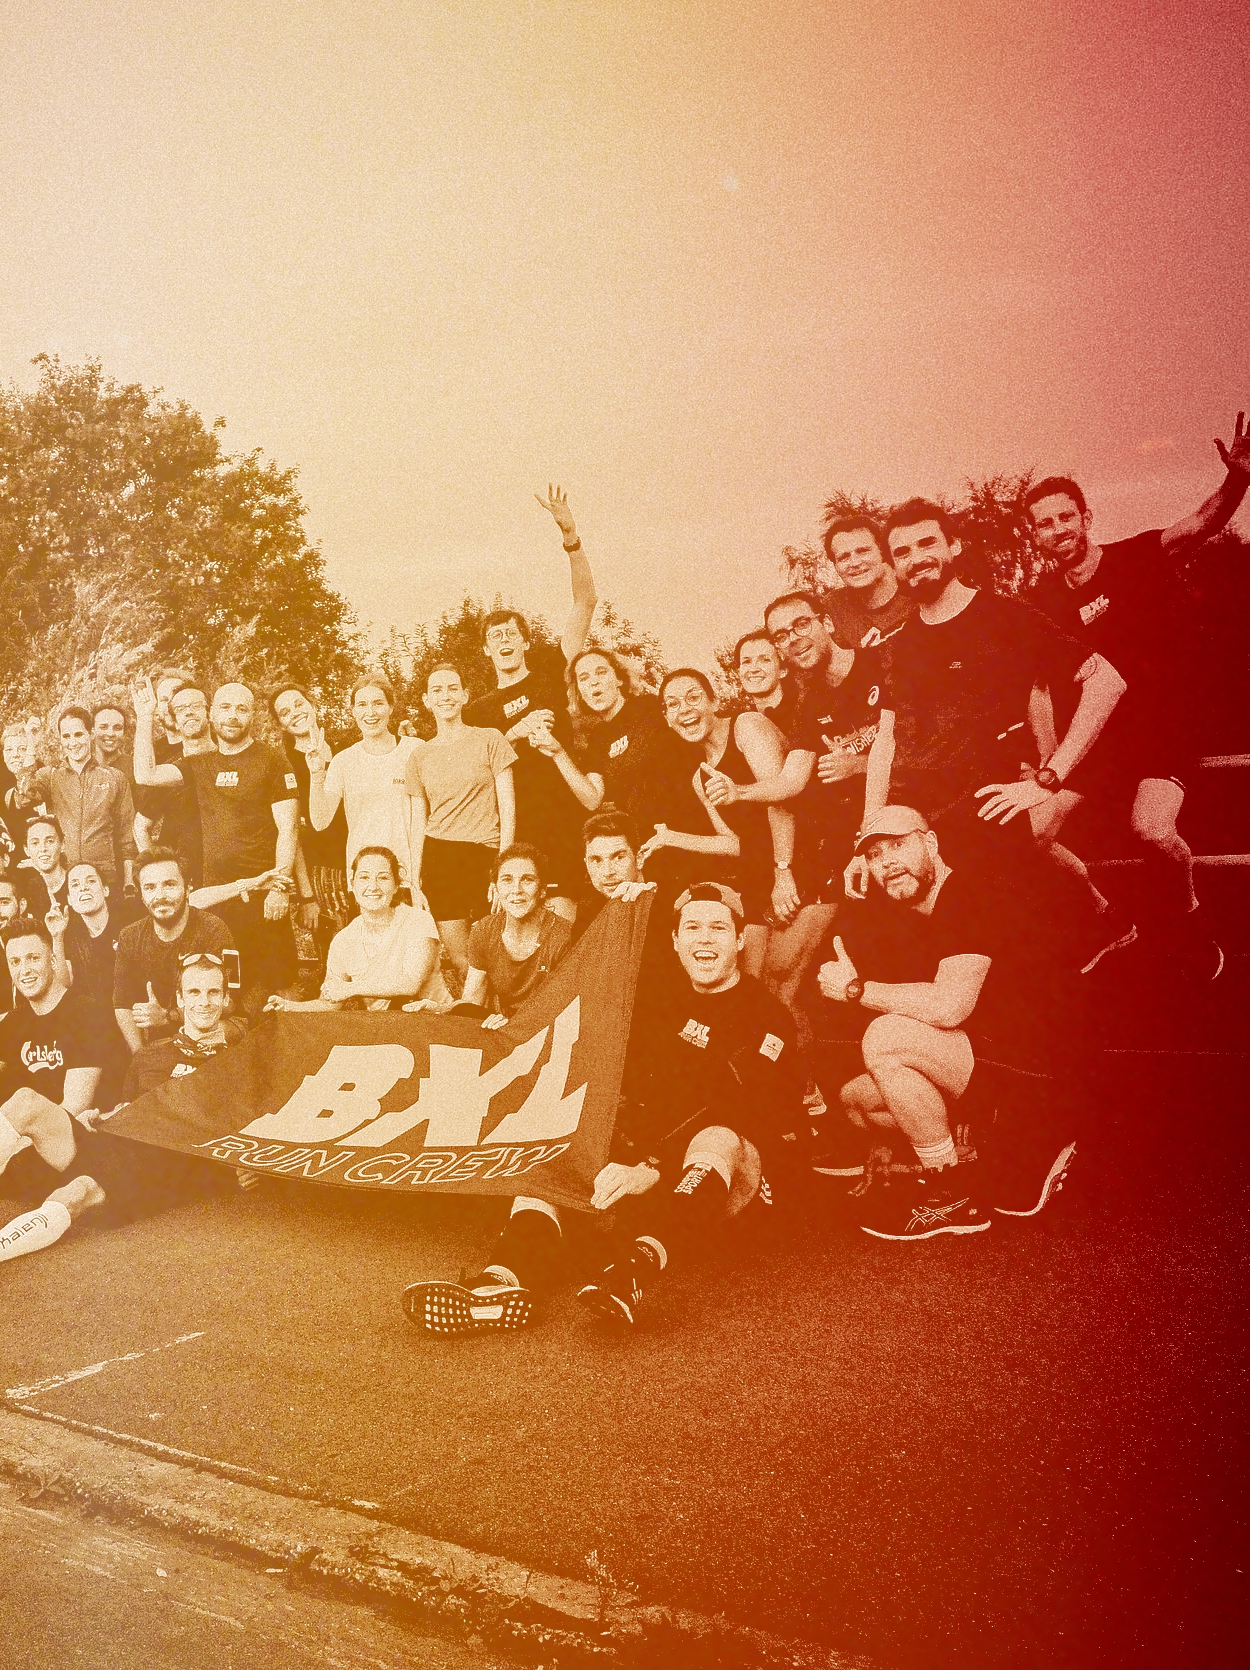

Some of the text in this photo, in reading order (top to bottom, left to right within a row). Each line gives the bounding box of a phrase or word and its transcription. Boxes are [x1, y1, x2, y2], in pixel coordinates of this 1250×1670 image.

[682, 1018, 711, 1042] BXL
[238, 995, 588, 1148] BXL
[192, 1135, 571, 1185] RUN CREW
